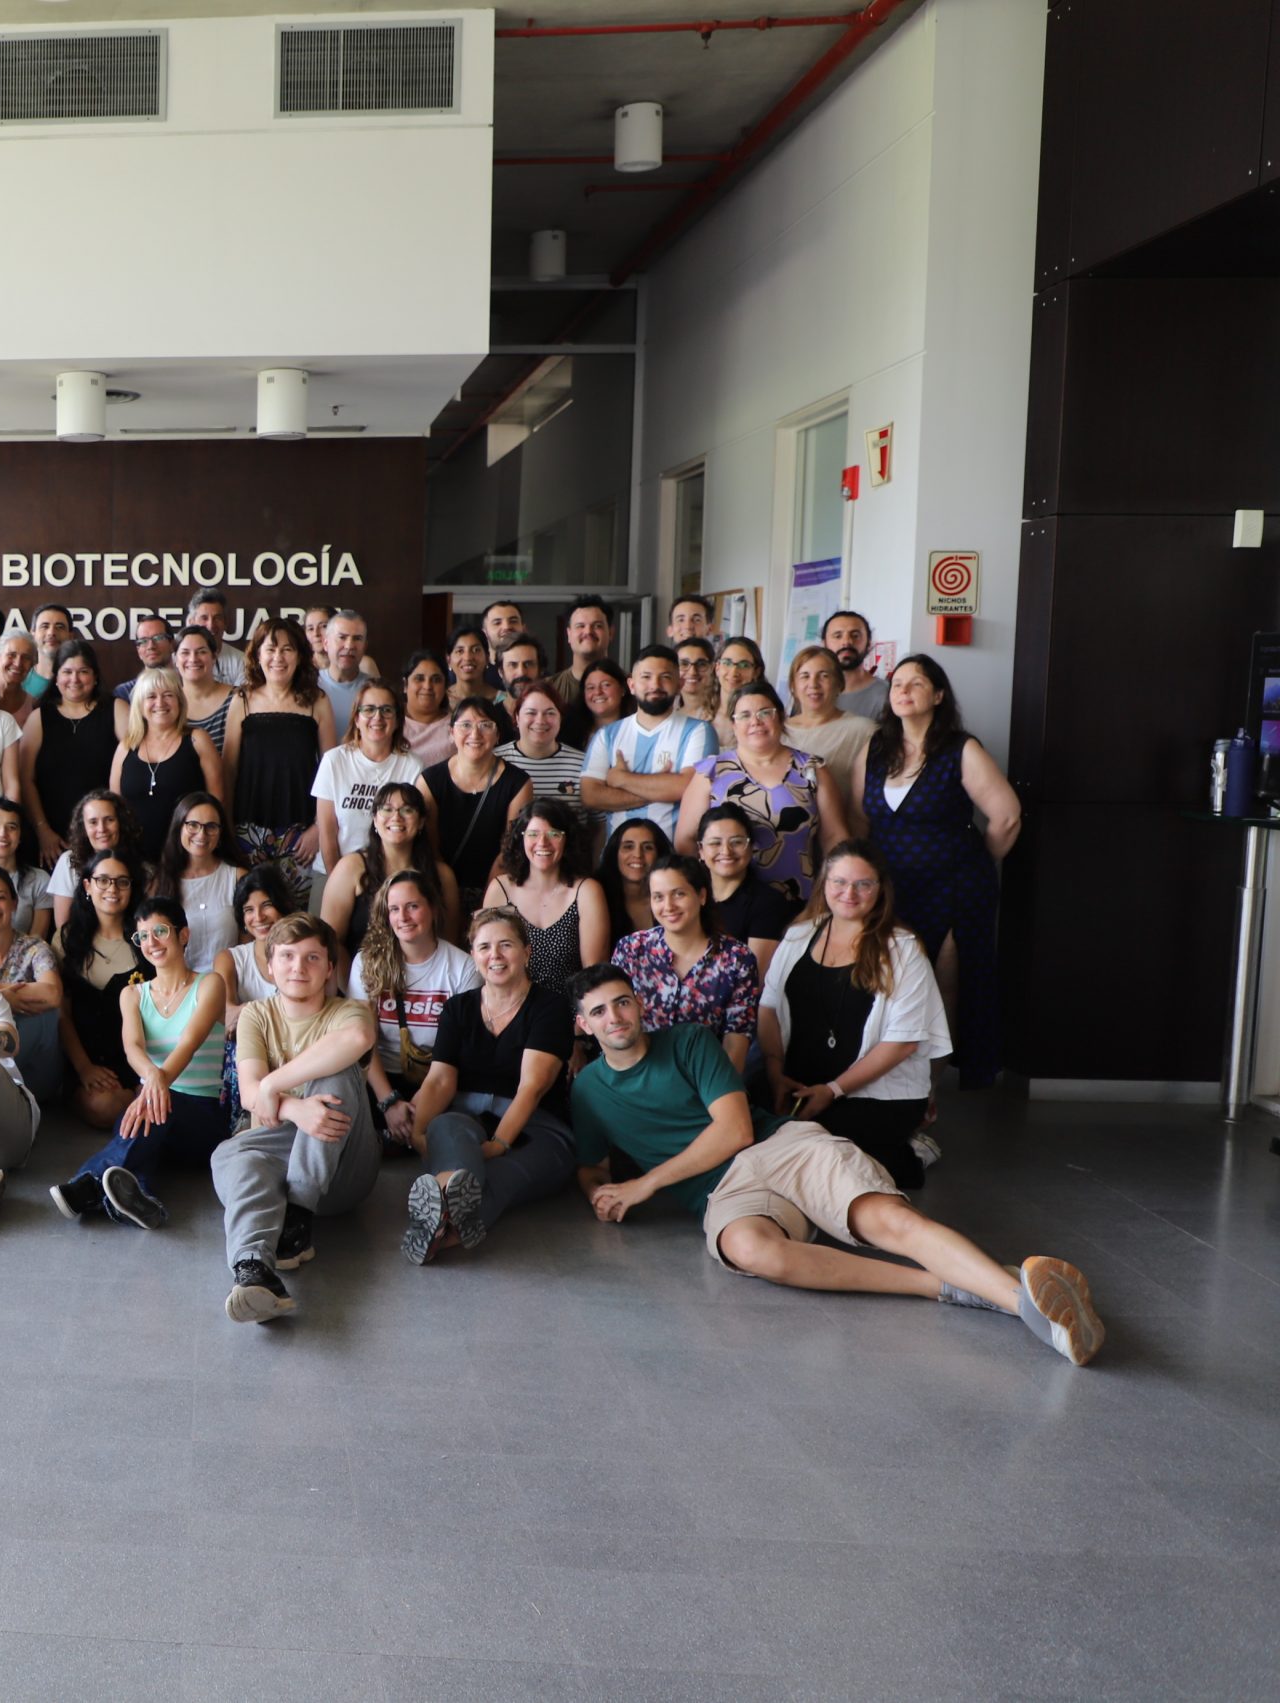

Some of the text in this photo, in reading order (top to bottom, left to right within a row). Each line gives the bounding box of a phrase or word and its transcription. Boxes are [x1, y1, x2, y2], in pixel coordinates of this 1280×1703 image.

[2, 543, 364, 588] BIOTECNOLOGÍA
[350, 783, 379, 797] PAIN
[341, 796, 375, 810] CHOC
